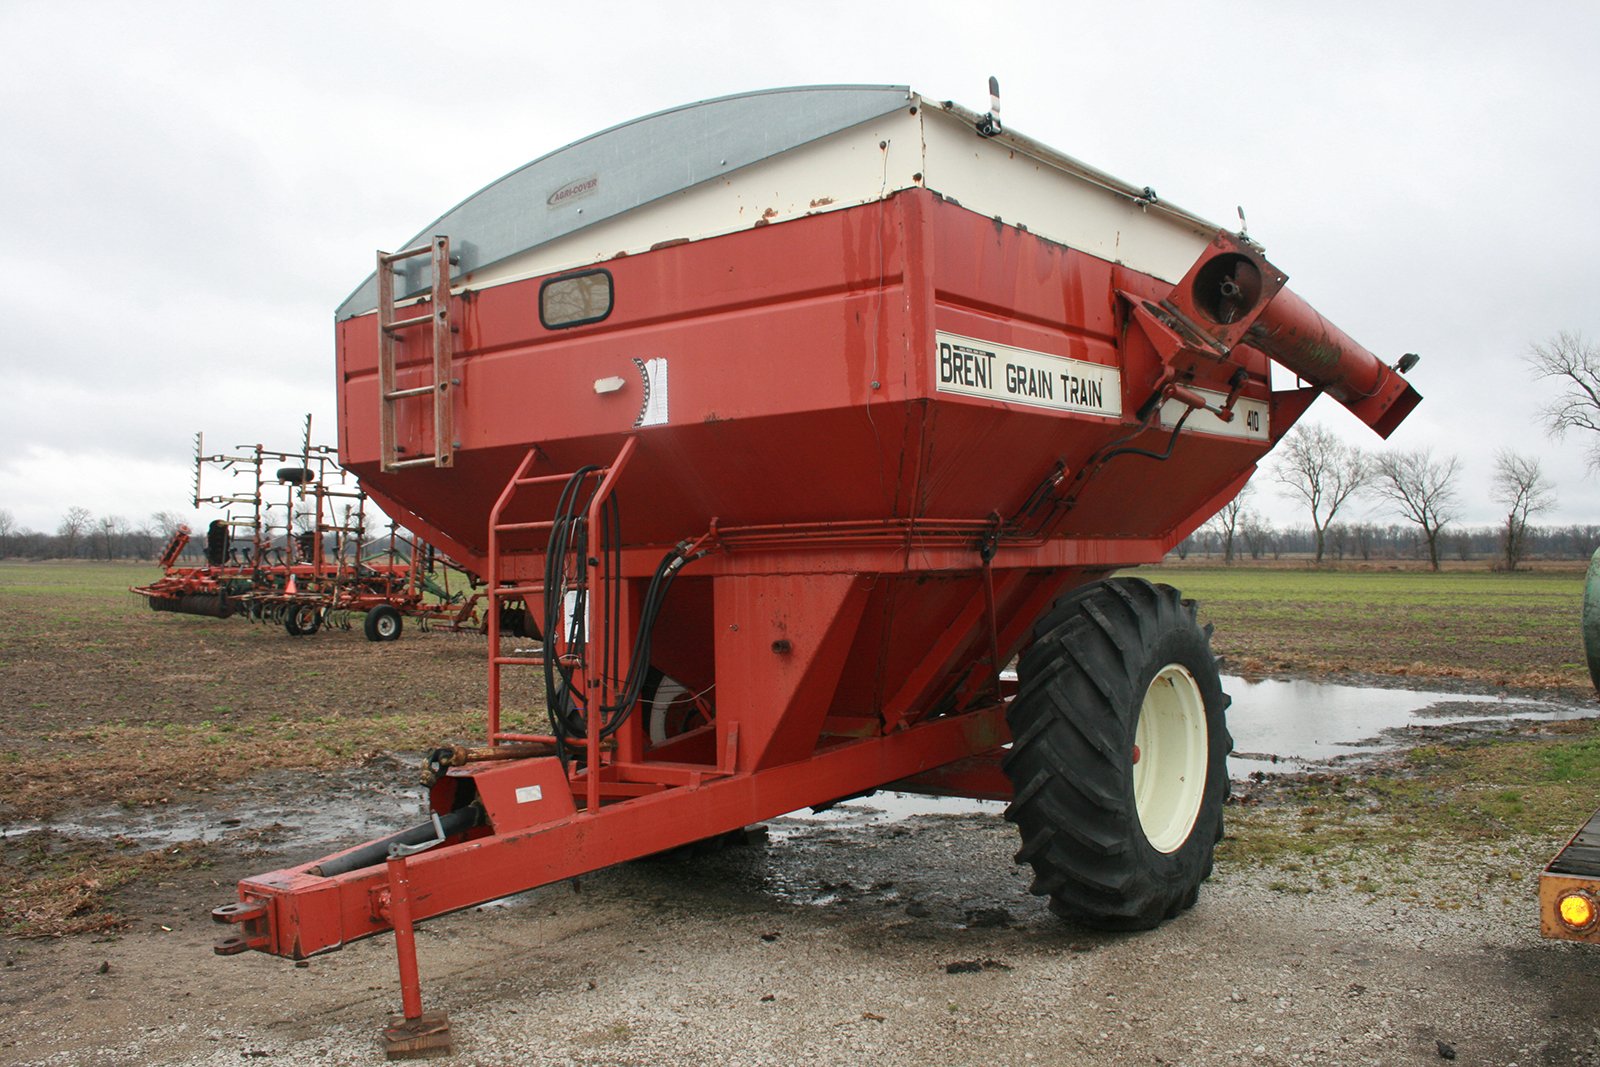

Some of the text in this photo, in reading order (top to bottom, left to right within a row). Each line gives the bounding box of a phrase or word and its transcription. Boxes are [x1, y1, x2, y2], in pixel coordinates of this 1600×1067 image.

[555, 178, 597, 201] AGRI-COVER
[940, 342, 1103, 408] BRENT GRAIN TRAIN
[1247, 410, 1259, 431] 410
